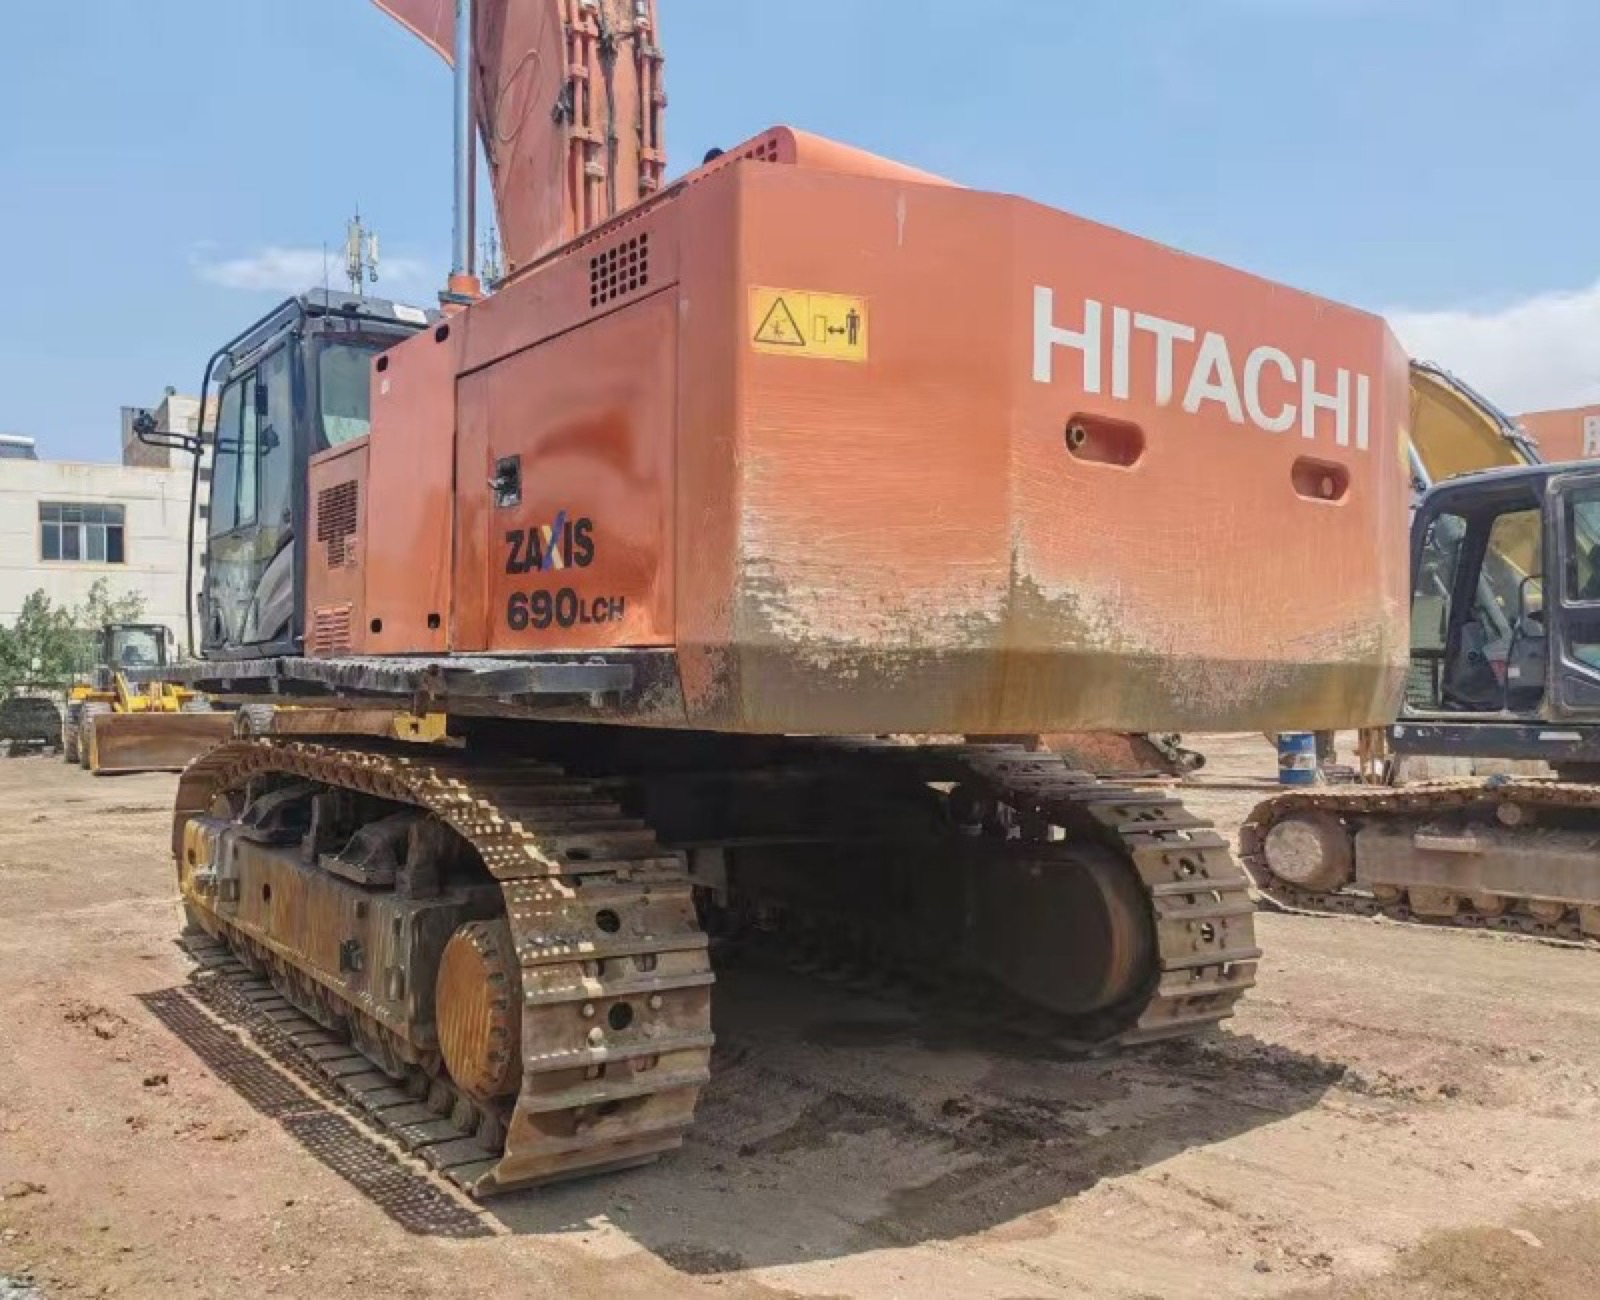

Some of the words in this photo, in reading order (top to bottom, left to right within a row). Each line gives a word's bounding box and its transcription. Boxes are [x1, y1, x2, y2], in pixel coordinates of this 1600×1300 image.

[1033, 285, 1369, 450] HITACHI
[506, 510, 594, 574] ZAXIS
[508, 588, 624, 631] 690LCH
